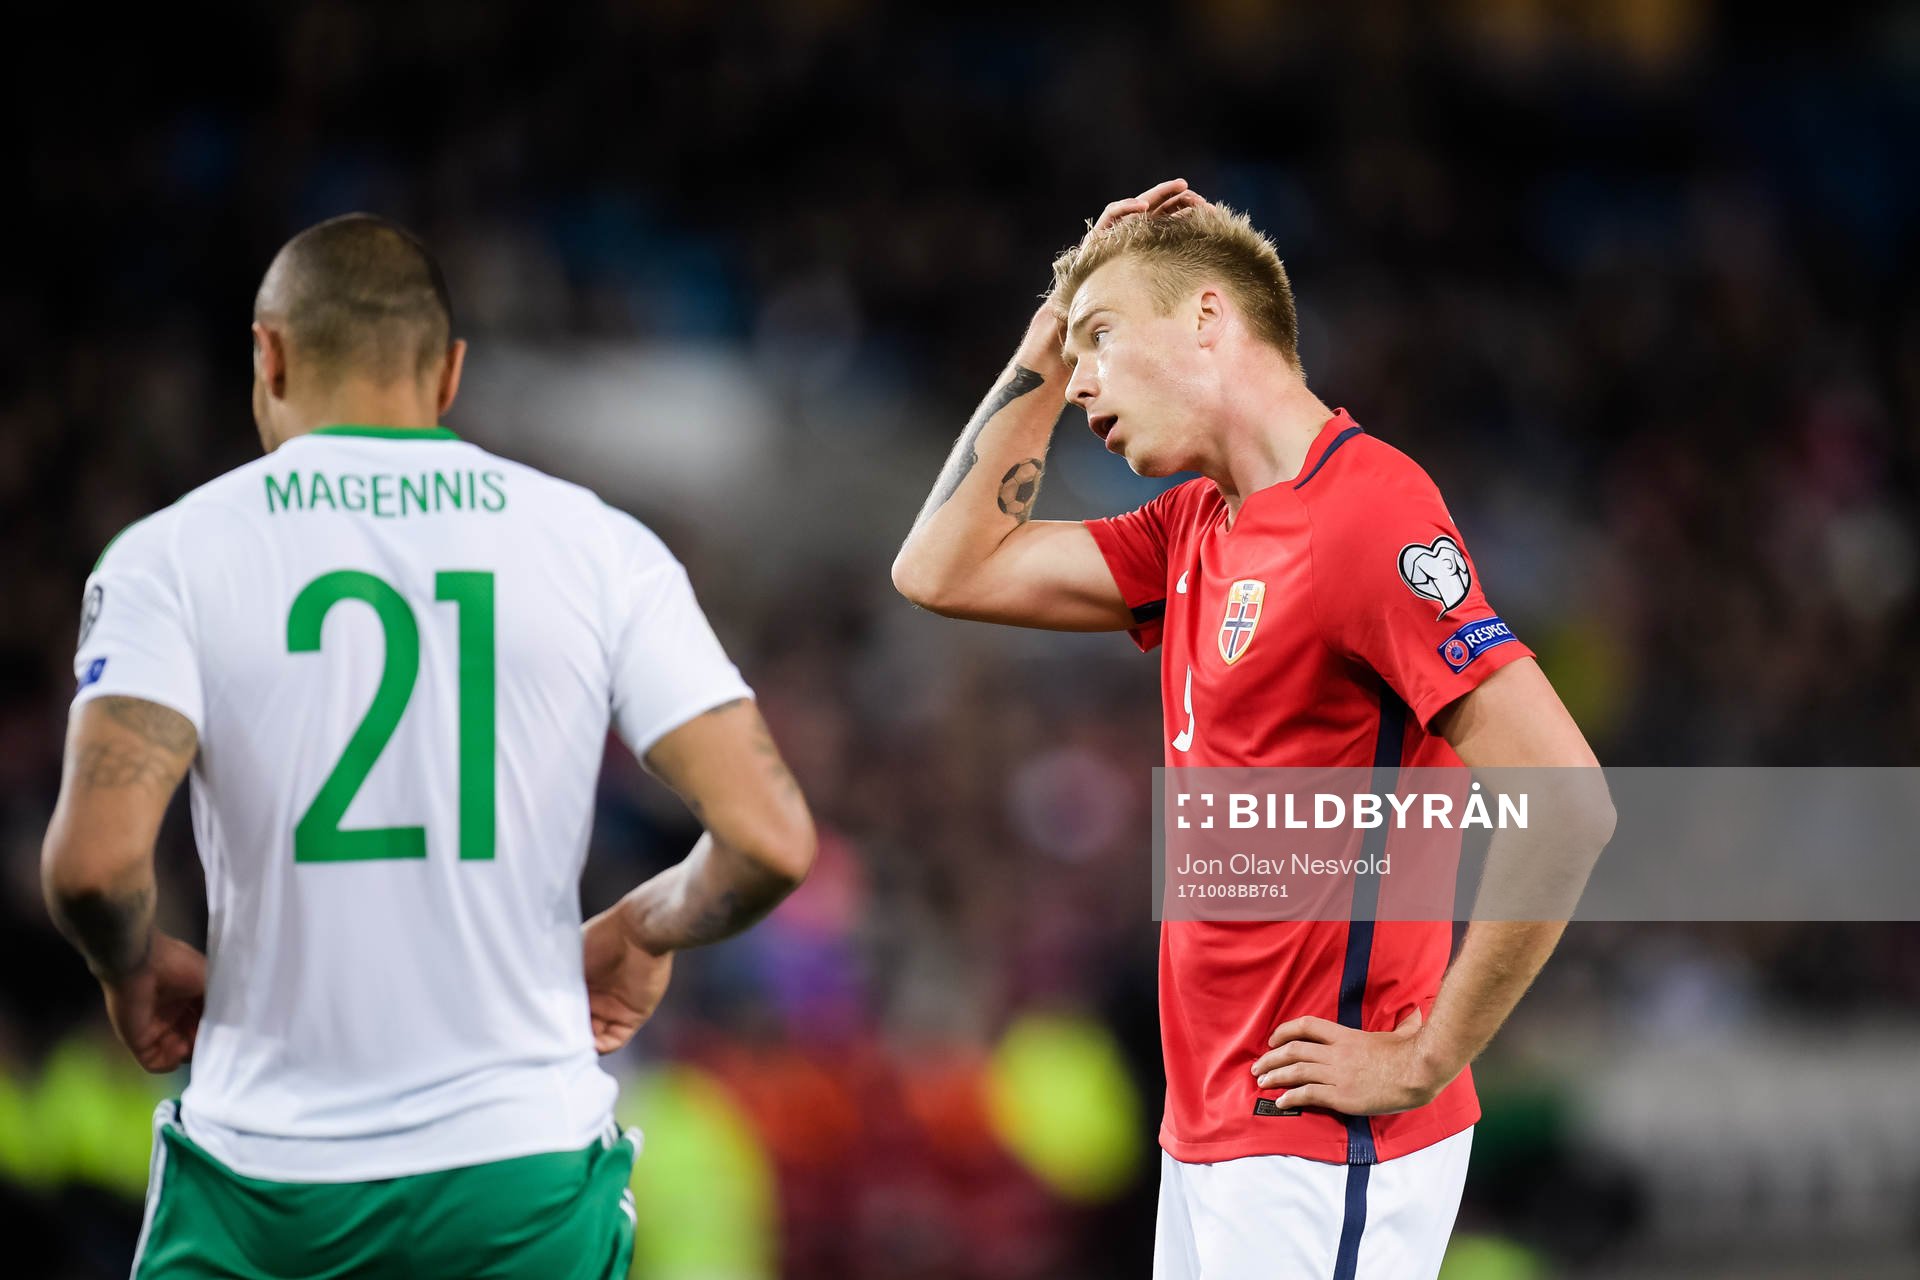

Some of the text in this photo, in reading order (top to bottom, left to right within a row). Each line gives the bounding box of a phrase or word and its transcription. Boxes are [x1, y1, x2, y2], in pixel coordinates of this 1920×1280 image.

[264, 469, 507, 517] MAGENNIS
[1465, 622, 1511, 648] RESPECT
[286, 569, 496, 863] 21
